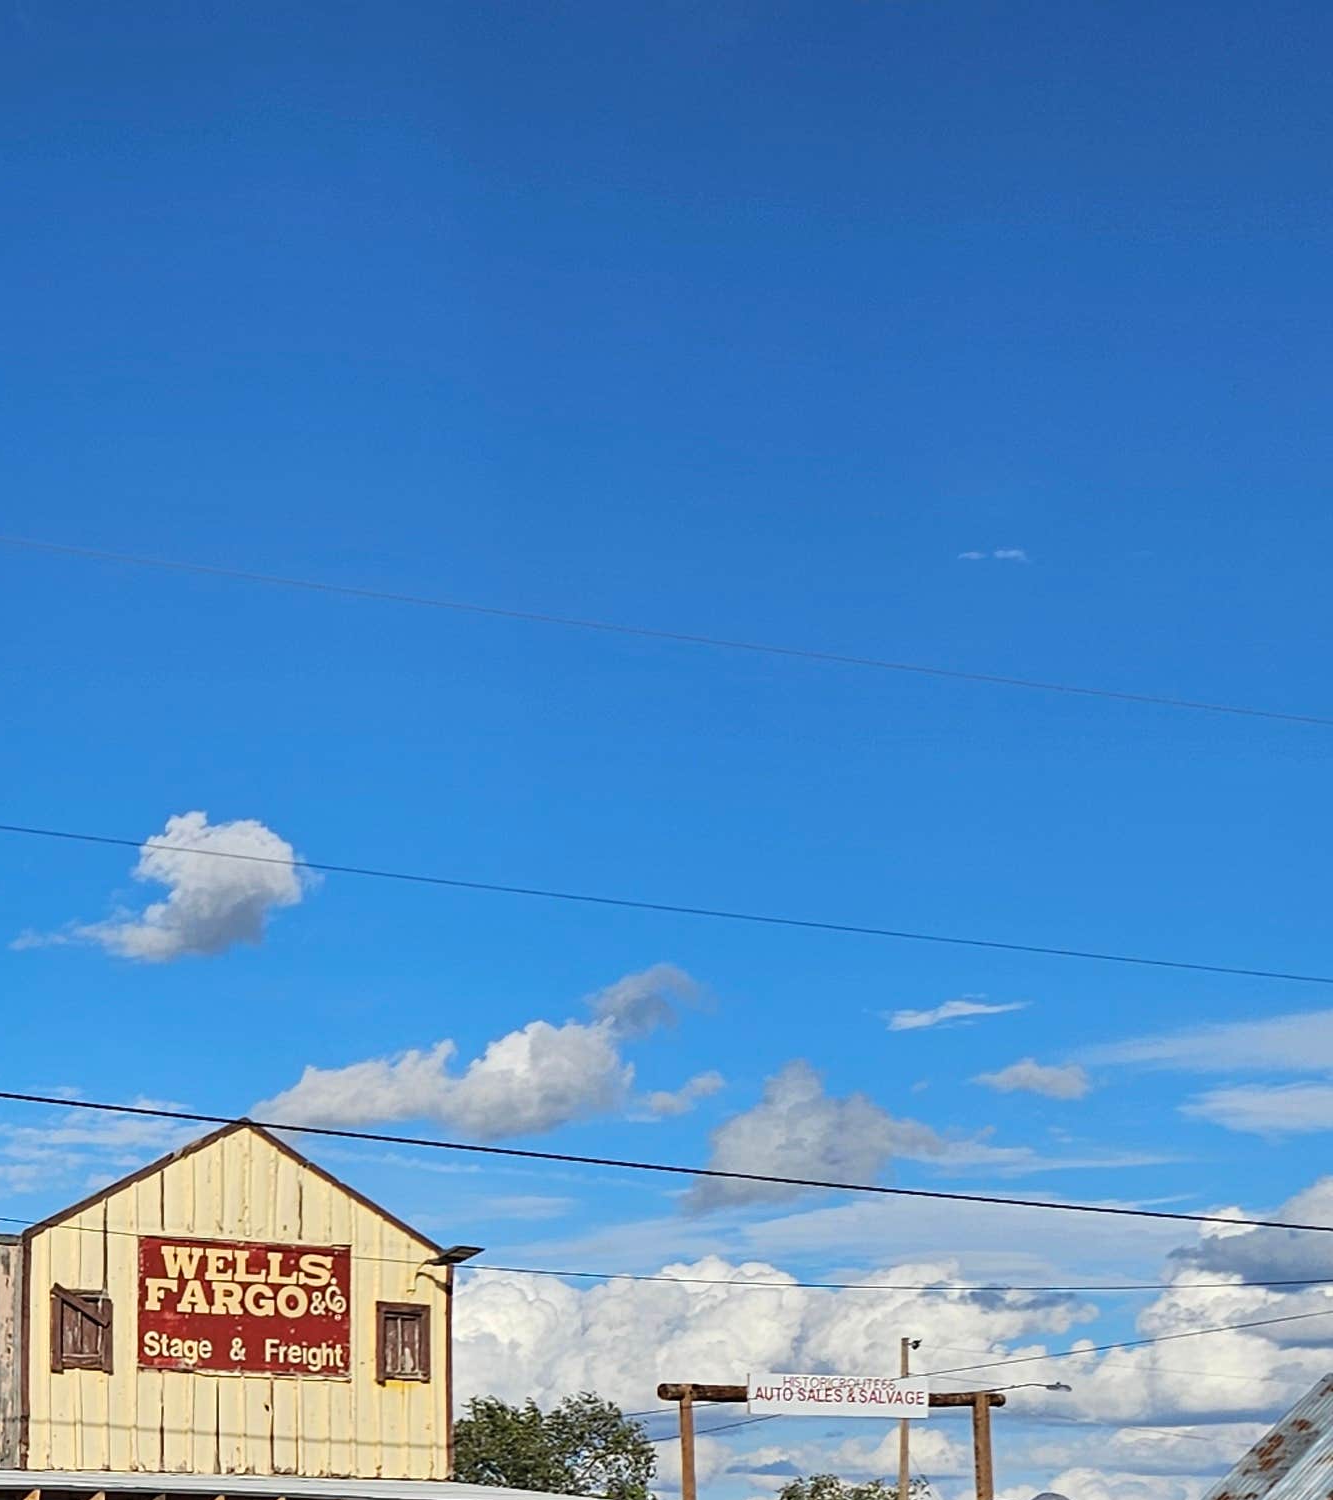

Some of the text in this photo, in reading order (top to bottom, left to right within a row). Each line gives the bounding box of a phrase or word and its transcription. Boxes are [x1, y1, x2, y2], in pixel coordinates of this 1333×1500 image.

[145, 1278, 308, 1318] FARGO
[143, 1331, 344, 1372] Stage & Freight
[755, 1387, 925, 1405] AUTO SALES & SALVAGE
